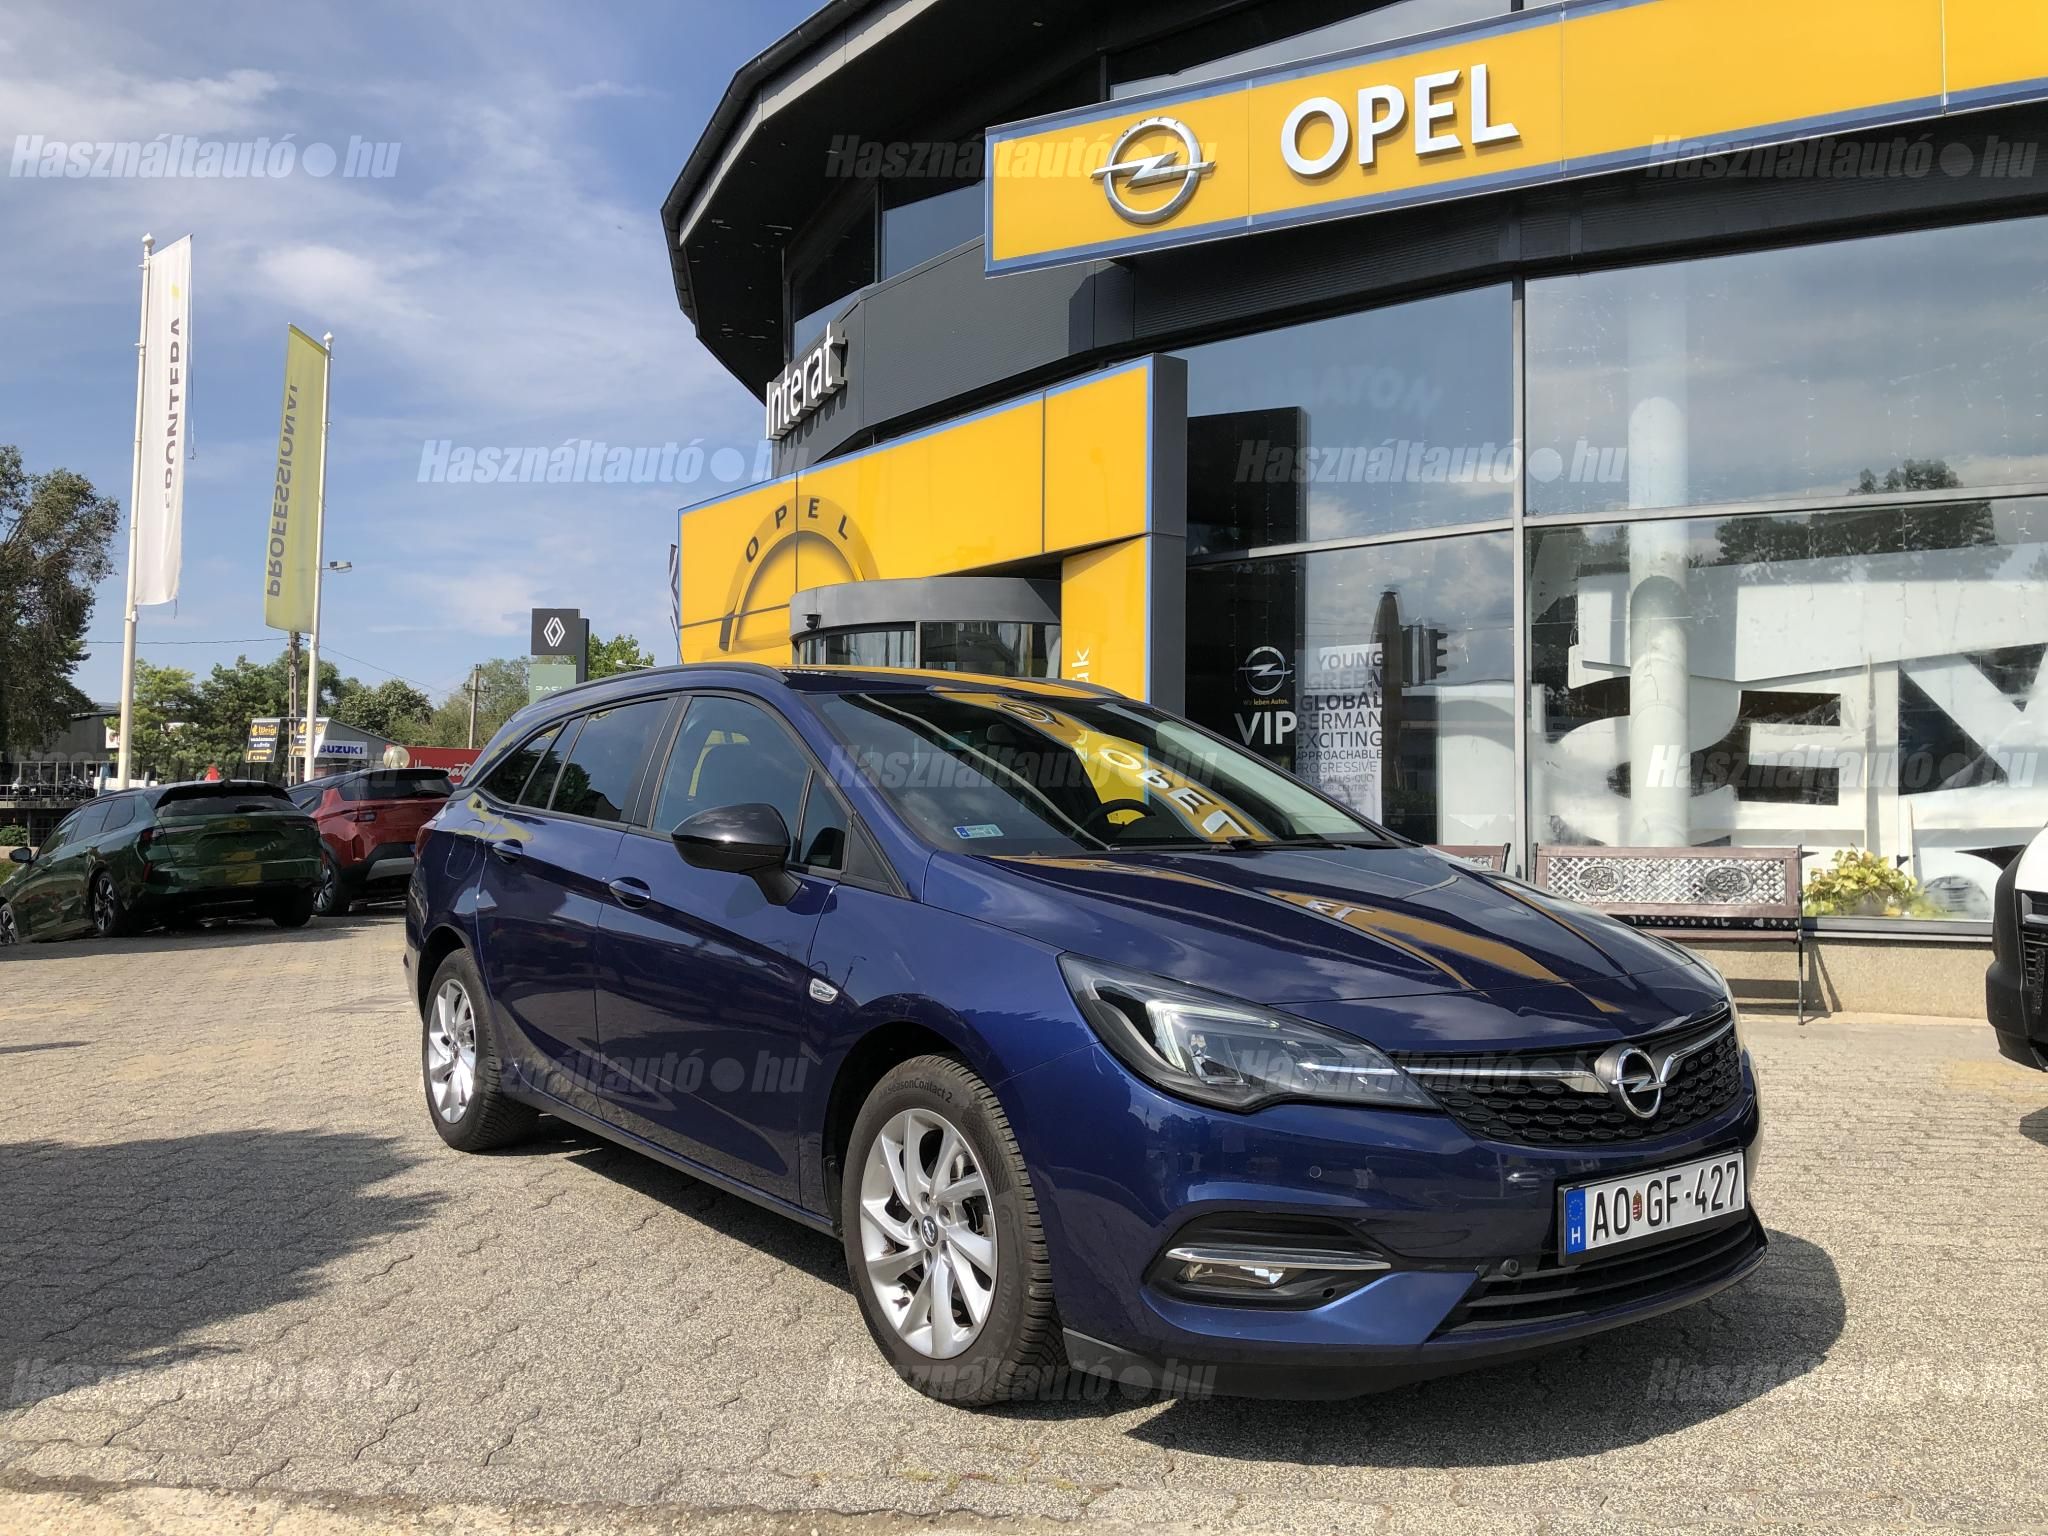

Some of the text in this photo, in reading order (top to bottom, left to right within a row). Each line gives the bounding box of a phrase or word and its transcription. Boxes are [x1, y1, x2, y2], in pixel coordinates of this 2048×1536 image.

[1280, 63, 1521, 175] OPEL
[766, 321, 835, 440] Interat
[745, 497, 848, 563] OPEL
[1317, 651, 1383, 671] YOUNG
[1307, 669, 1382, 687] GREEN
[1300, 691, 1382, 711] GLOBAL
[1234, 711, 1297, 745] VIP
[1297, 711, 1382, 731] GERMAN
[1297, 730, 1382, 749] EXCITING
[1296, 749, 1383, 761] APPROACHABLE
[1296, 760, 1378, 774] PROGRESSIVE
[1571, 1226, 1581, 1246] H
